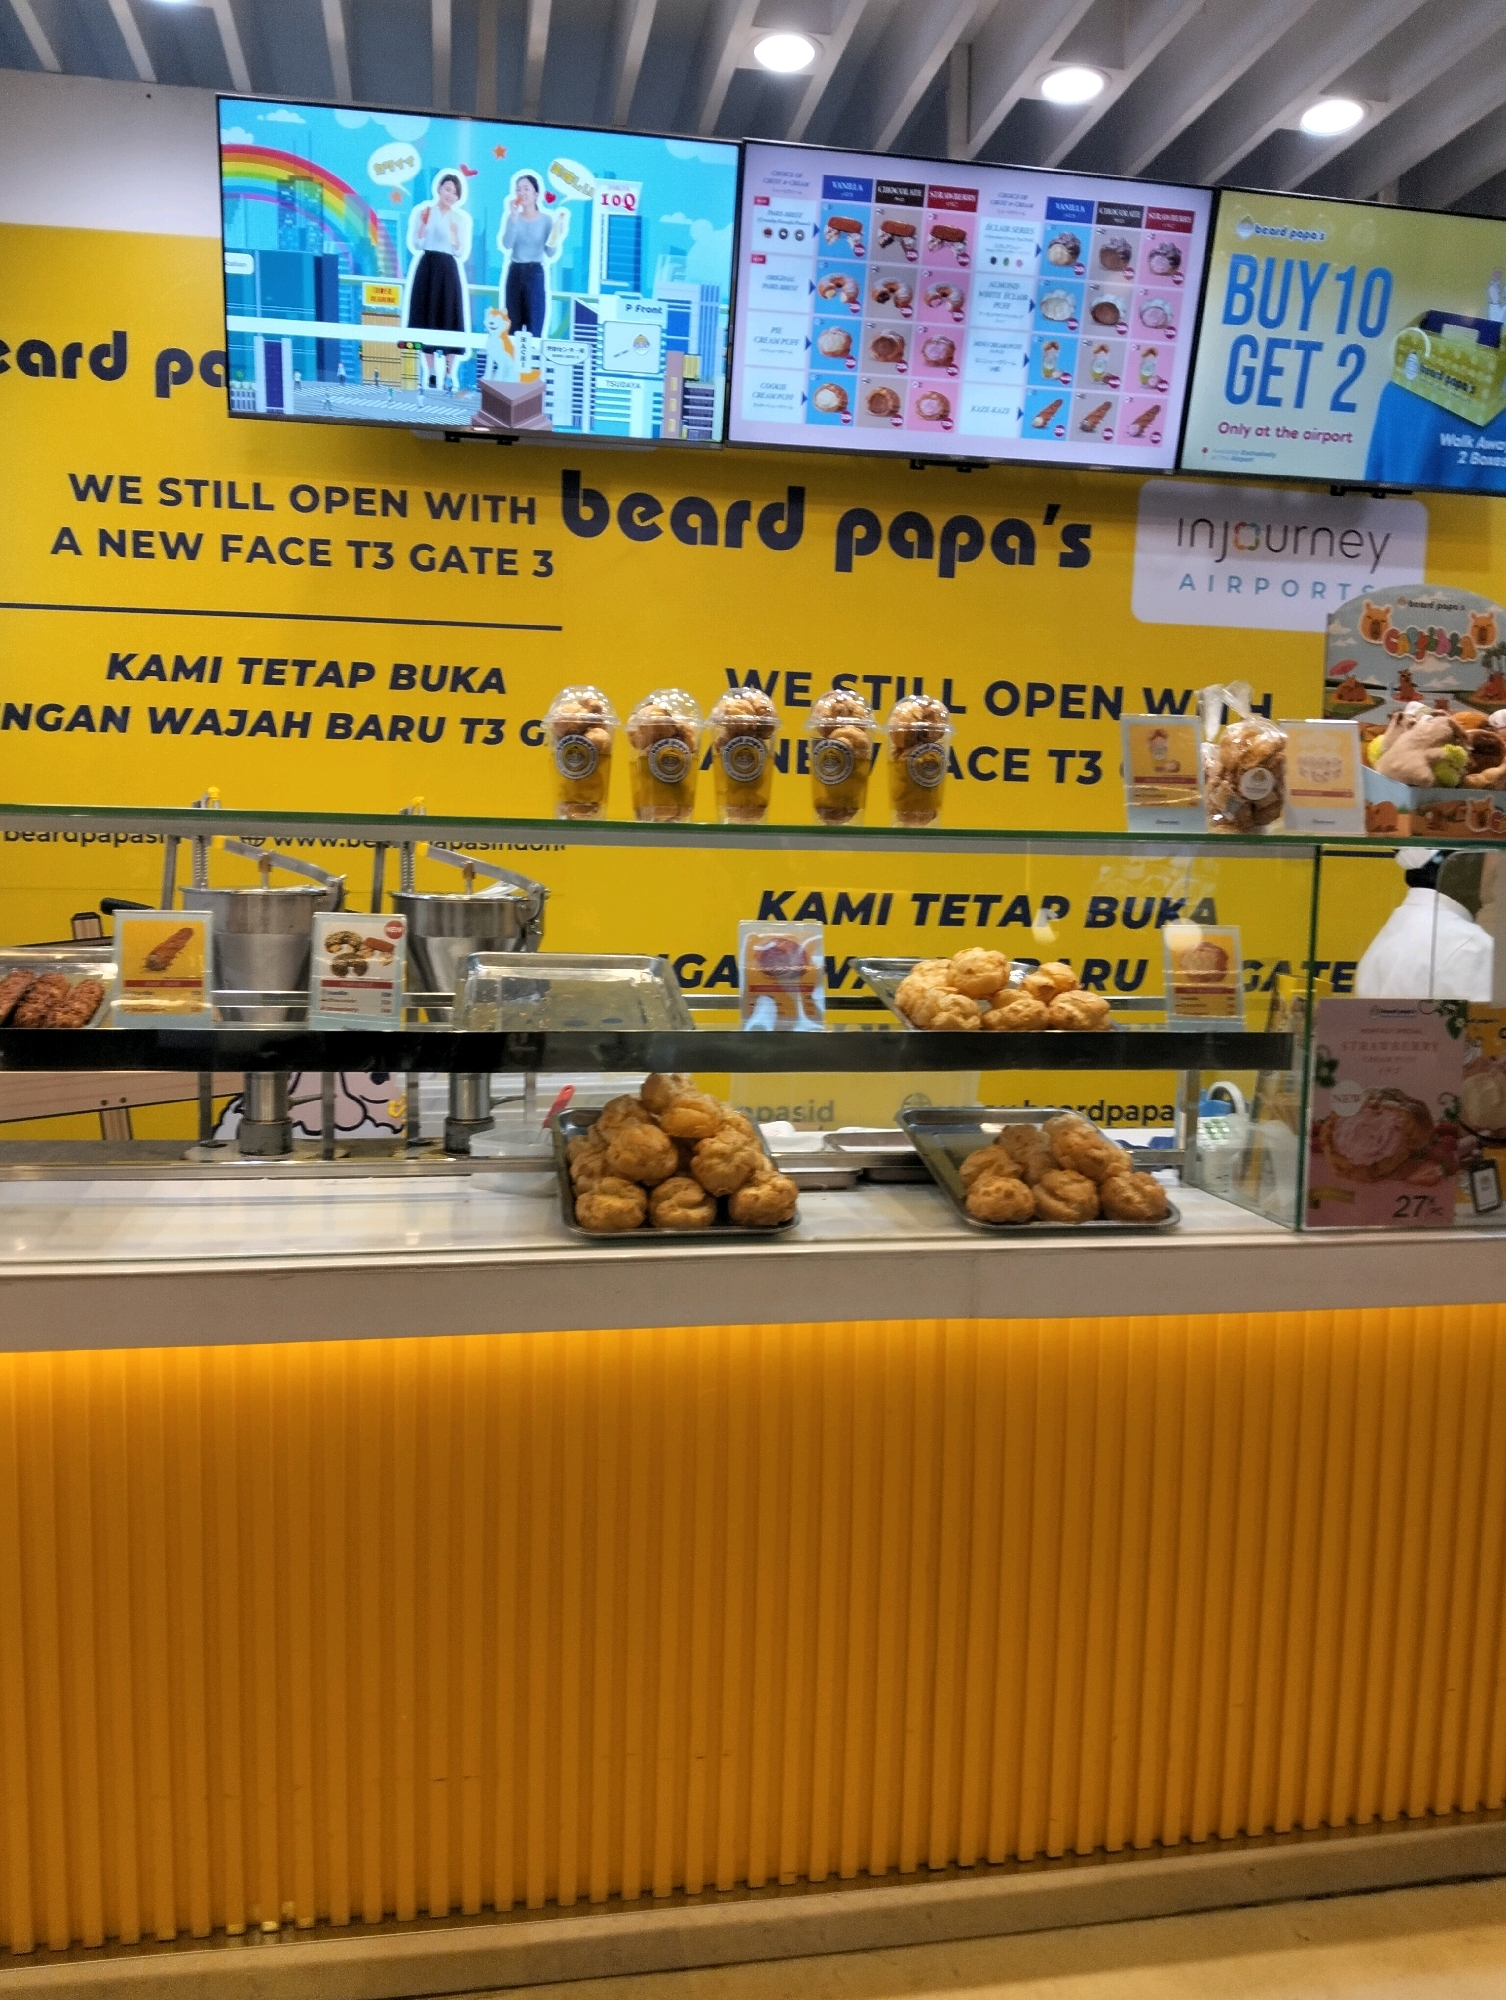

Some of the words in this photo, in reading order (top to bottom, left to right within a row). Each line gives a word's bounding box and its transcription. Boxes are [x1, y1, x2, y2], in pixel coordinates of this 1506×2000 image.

[1255, 224, 1287, 236] beard
[1222, 253, 1331, 332] BUY
[1335, 264, 1394, 339] 10
[1225, 334, 1324, 409] GET
[1330, 343, 1368, 413] 2
[1218, 421, 1251, 439] Only
[1254, 426, 1270, 437] at
[1275, 426, 1299, 439] the
[1303, 427, 1354, 444] airport
[68, 473, 143, 505] WE
[158, 477, 275, 511] STILL
[289, 483, 408, 519] OPEN
[424, 491, 536, 525] WITH
[562, 469, 806, 551] beard
[834, 503, 1092, 579] papa's
[50, 526, 83, 556] A
[98, 528, 204, 561] NEW
[221, 533, 332, 567] FACE
[346, 539, 395, 571] T3
[410, 543, 519, 577] GATE
[532, 549, 554, 578] 3
[106, 652, 223, 684] KAMI
[238, 656, 376, 689] TETAP
[389, 663, 507, 695] BUKA
[984, 680, 1124, 721] OPEN
[148, 706, 313, 739] WAJAH
[326, 712, 447, 744] BARU
[460, 717, 506, 746] T3
[1047, 750, 1103, 785] T3
[757, 890, 895, 926] KAMI
[911, 893, 1070, 928] TETAP
[1084, 895, 1219, 929] BUKA
